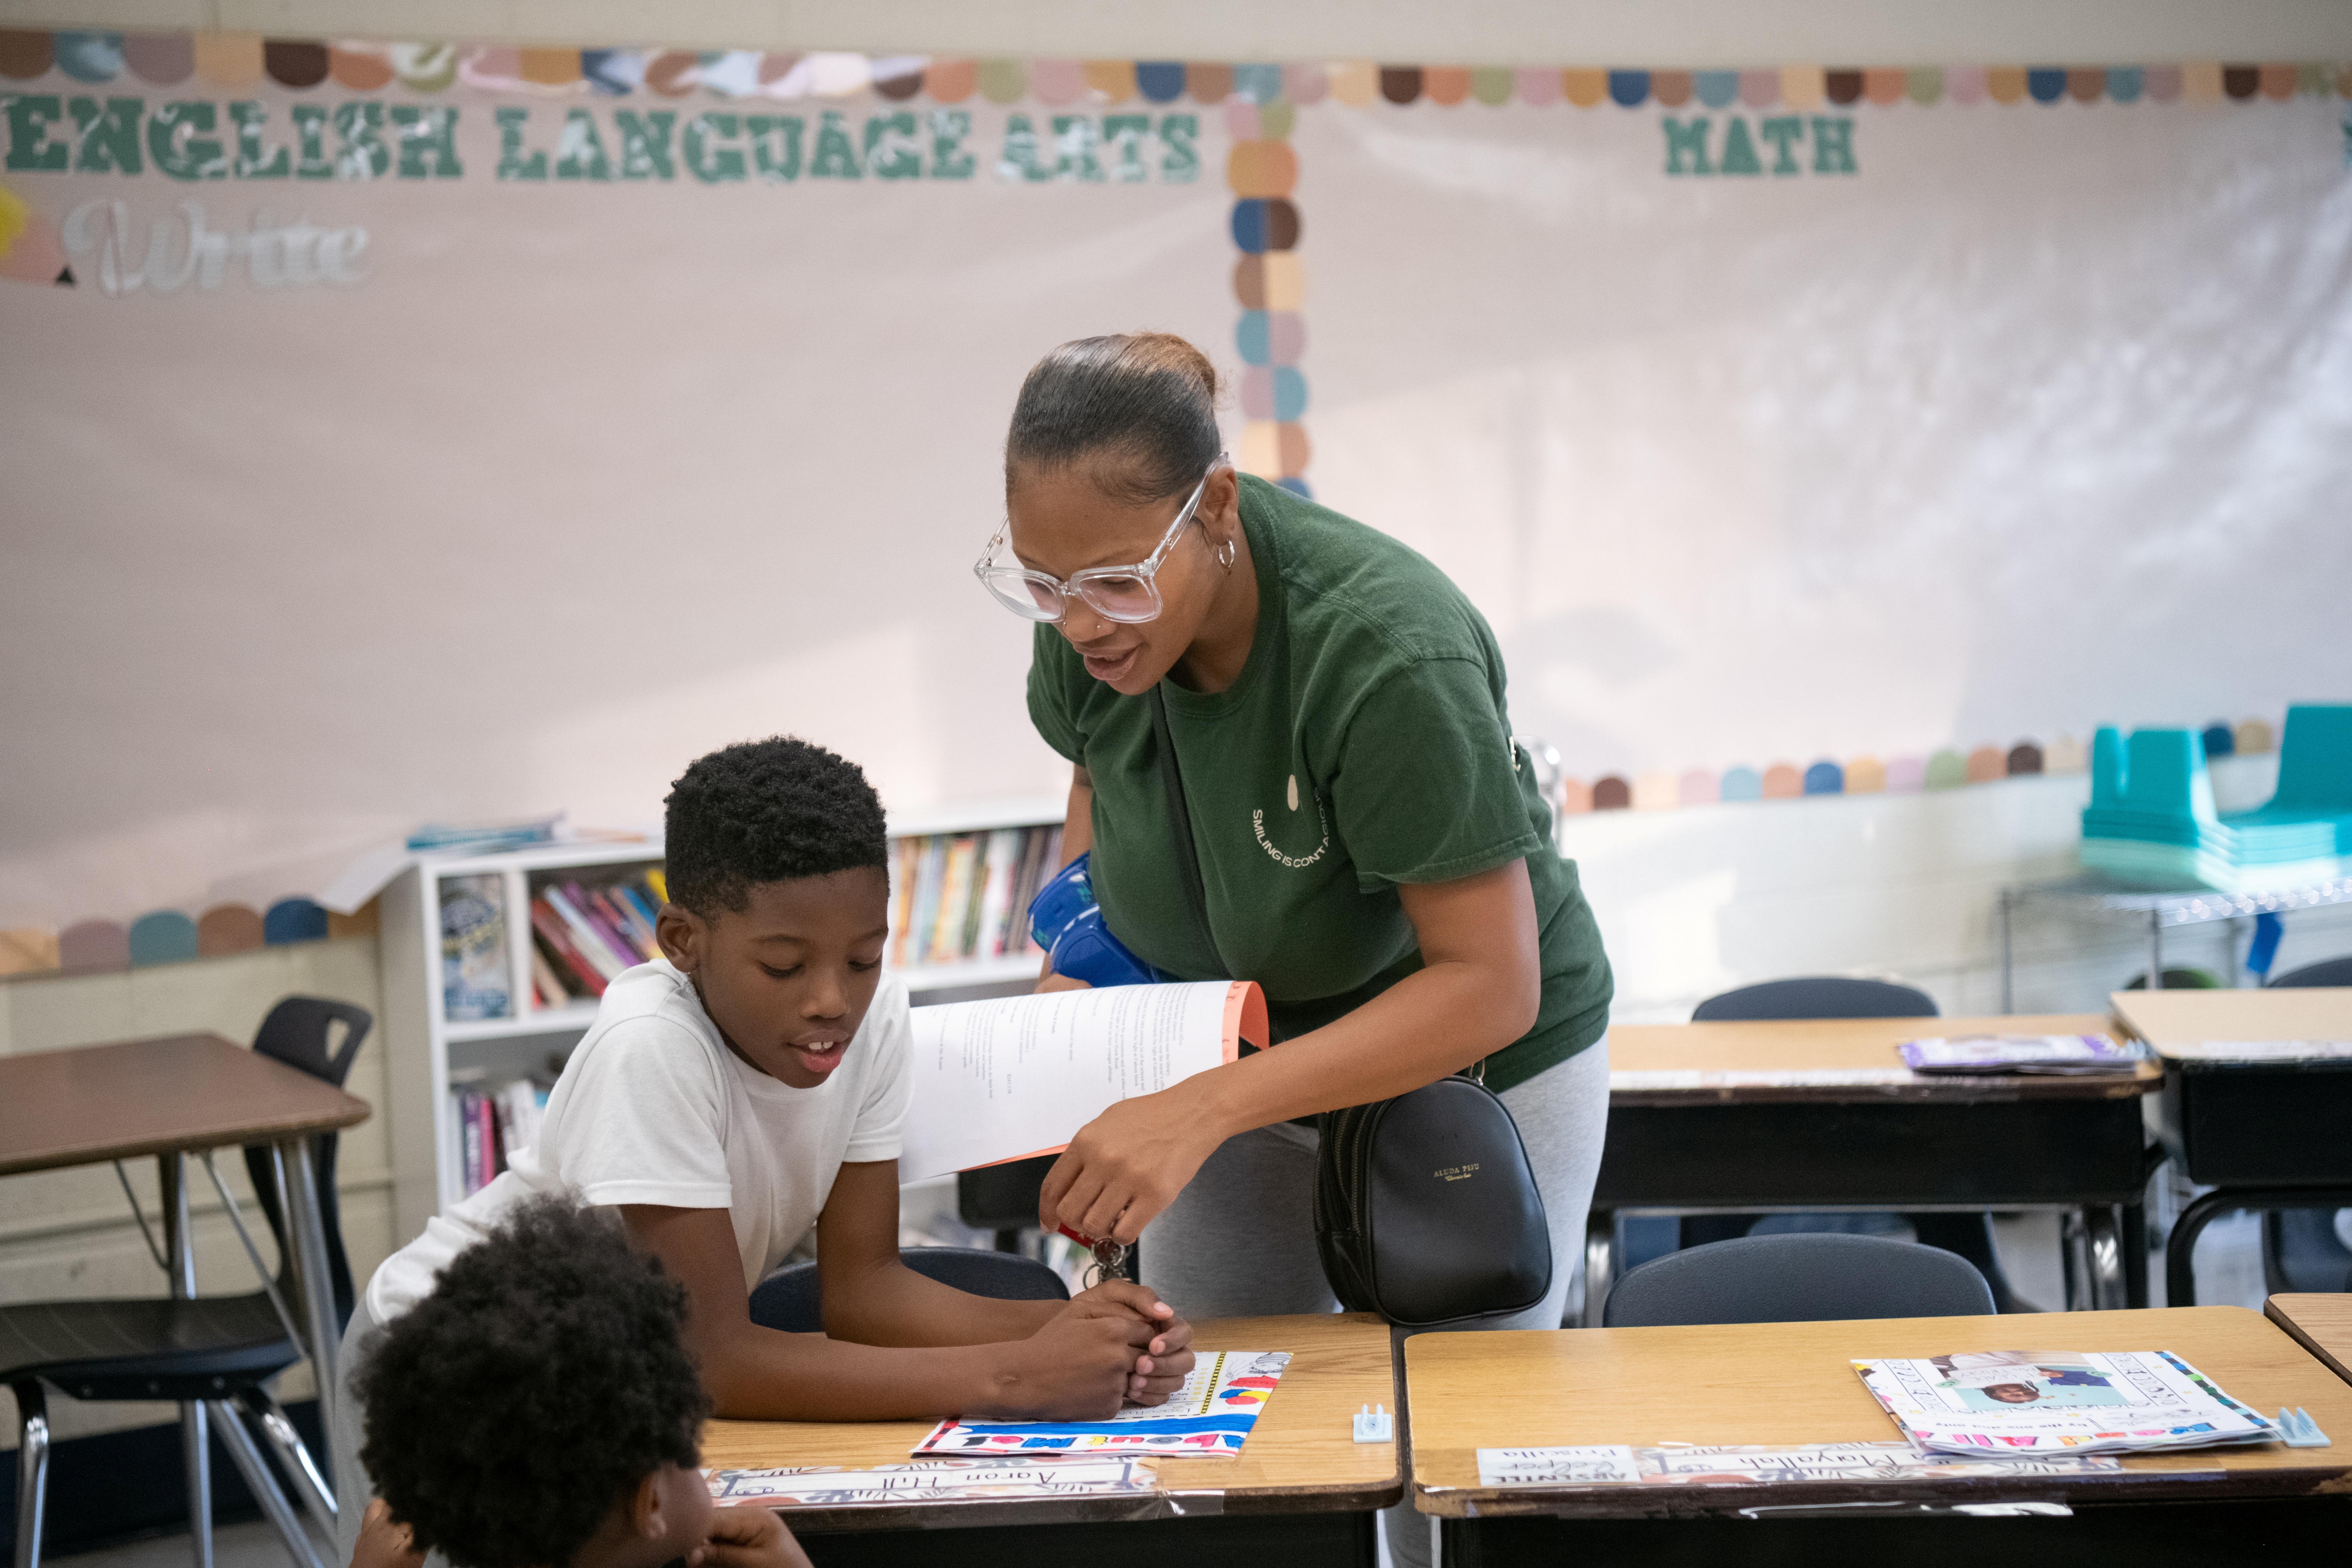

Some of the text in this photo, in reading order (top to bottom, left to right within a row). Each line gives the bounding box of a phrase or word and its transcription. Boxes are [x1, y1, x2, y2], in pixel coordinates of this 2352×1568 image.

[1, 92, 1200, 185] ENGLISH LANGUAGE ARTS
[1662, 116, 1857, 173] MATH
[62, 199, 372, 296] Write
[1253, 809, 1283, 860] SMILING
[1282, 856, 1293, 867] IS
[882, 1472, 1055, 1489] Aaron Hill
[1502, 1449, 1617, 1459] Priscilla
